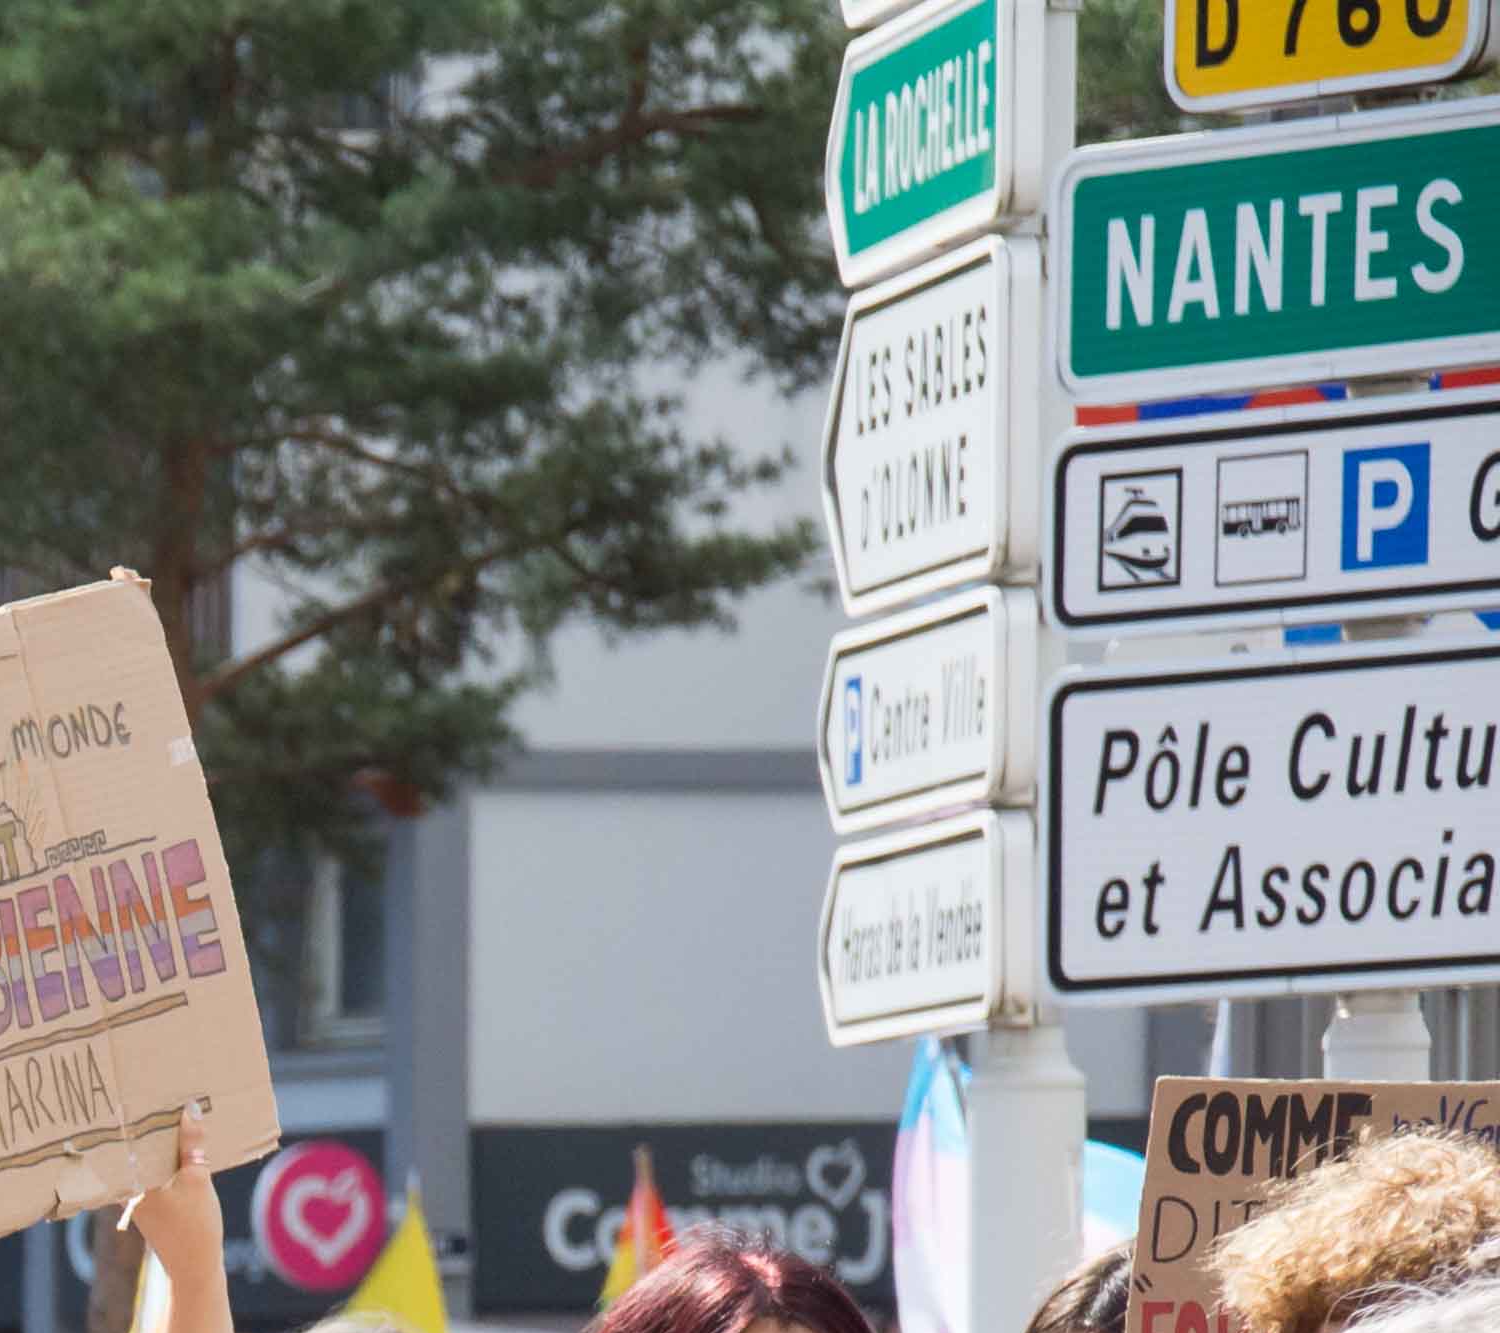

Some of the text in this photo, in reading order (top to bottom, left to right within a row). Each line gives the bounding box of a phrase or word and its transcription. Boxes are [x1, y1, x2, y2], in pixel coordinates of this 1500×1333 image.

[853, 39, 993, 215] LA ROCHELLE
[1106, 178, 1466, 331] NANTES
[857, 304, 988, 436] LES SABLES
[870, 684, 929, 764] Centre
[942, 653, 986, 746] Ville
[1093, 720, 1251, 815] Pôle
[1098, 860, 1166, 941] et
